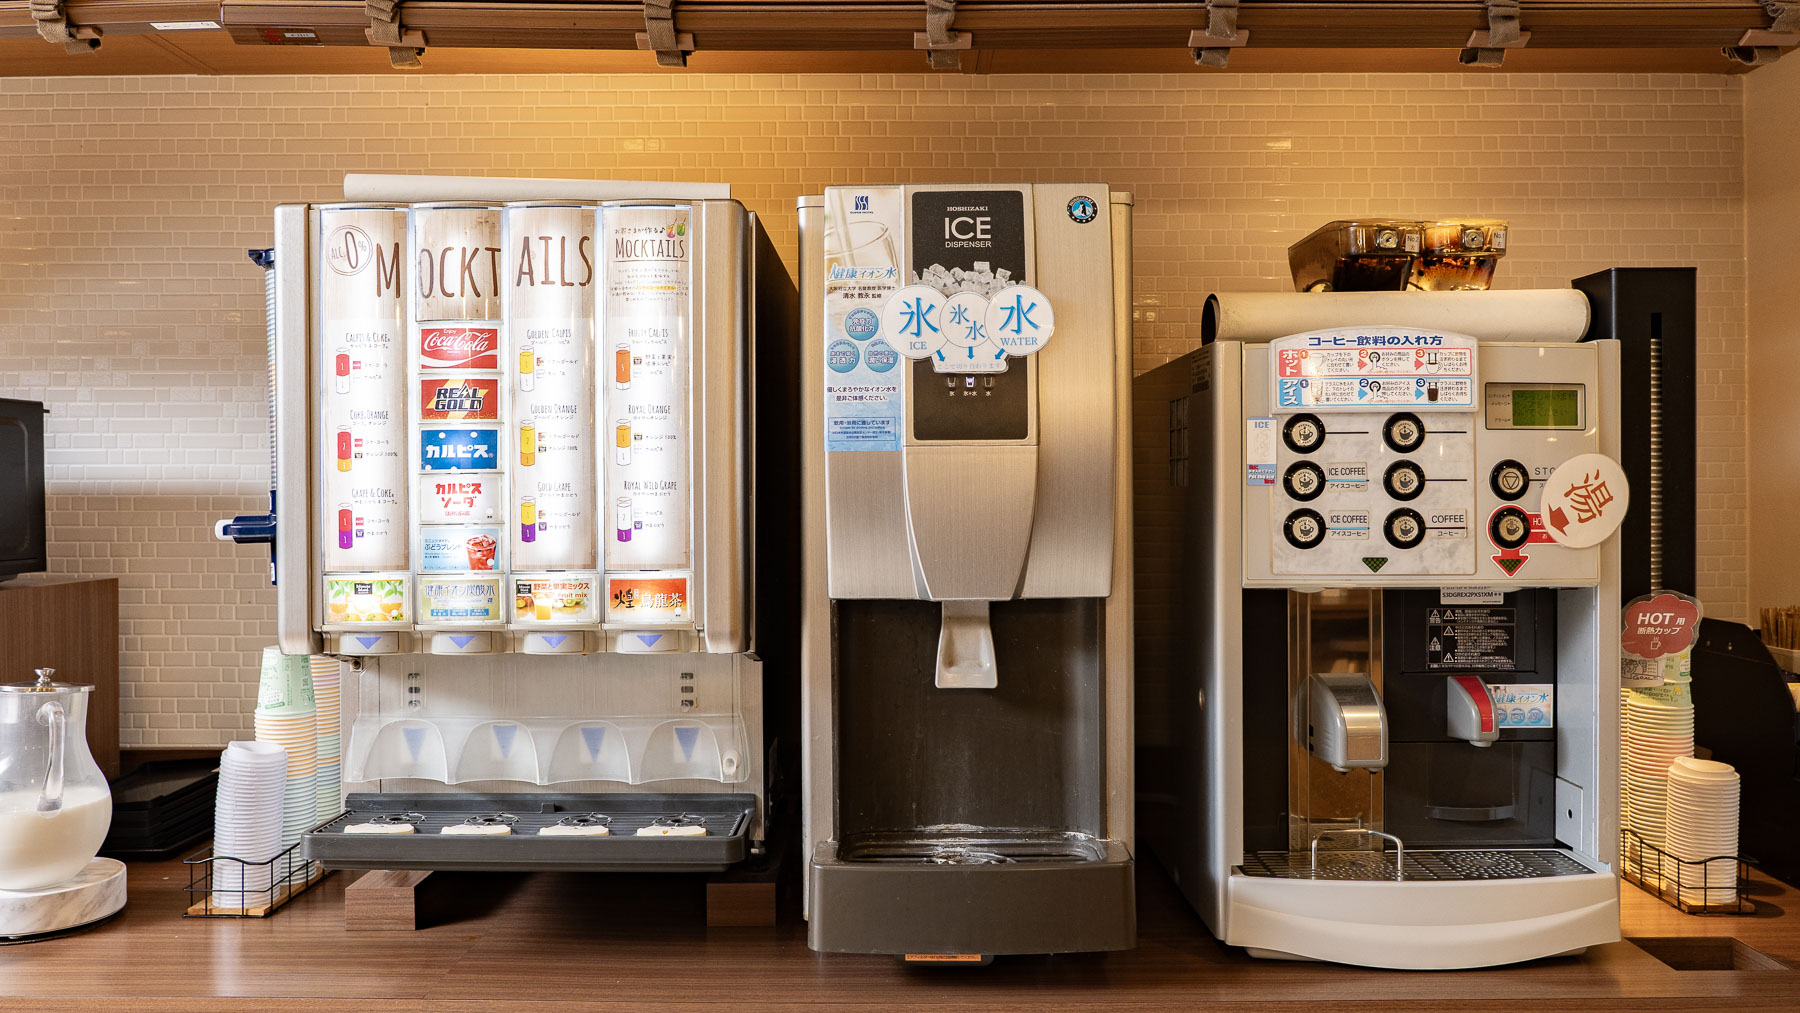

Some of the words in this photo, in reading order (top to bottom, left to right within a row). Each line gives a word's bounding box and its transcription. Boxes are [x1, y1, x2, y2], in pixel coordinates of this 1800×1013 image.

[944, 217, 991, 239] ICE
[898, 297, 941, 338] 氷
[950, 304, 970, 325] 氷
[999, 294, 1041, 335] 水
[965, 320, 986, 341] 水
[909, 341, 927, 350] ICE
[1000, 337, 1038, 346] WATER
[1308, 335, 1443, 346] コーヒー飲料の入れ方
[1282, 350, 1299, 376] ホット
[436, 384, 483, 399] REAL
[1282, 379, 1299, 405] アイス
[434, 399, 483, 411] GOLD
[1254, 421, 1270, 429] ICE
[1340, 467, 1366, 475] COFFEE
[436, 483, 482, 494] カルピス
[623, 480, 641, 490] ROYAL
[660, 480, 677, 490] GRAPE
[441, 496, 477, 508] ソーダ
[1330, 515, 1341, 523] ICE
[1342, 515, 1368, 523] COFFEE
[1431, 515, 1464, 523] COFFEE
[425, 584, 496, 597] 健康イオン炭酸水
[1637, 613, 1674, 625] HOT
[1675, 617, 1685, 625] 用
[1637, 627, 1681, 635] 断熱カップ
